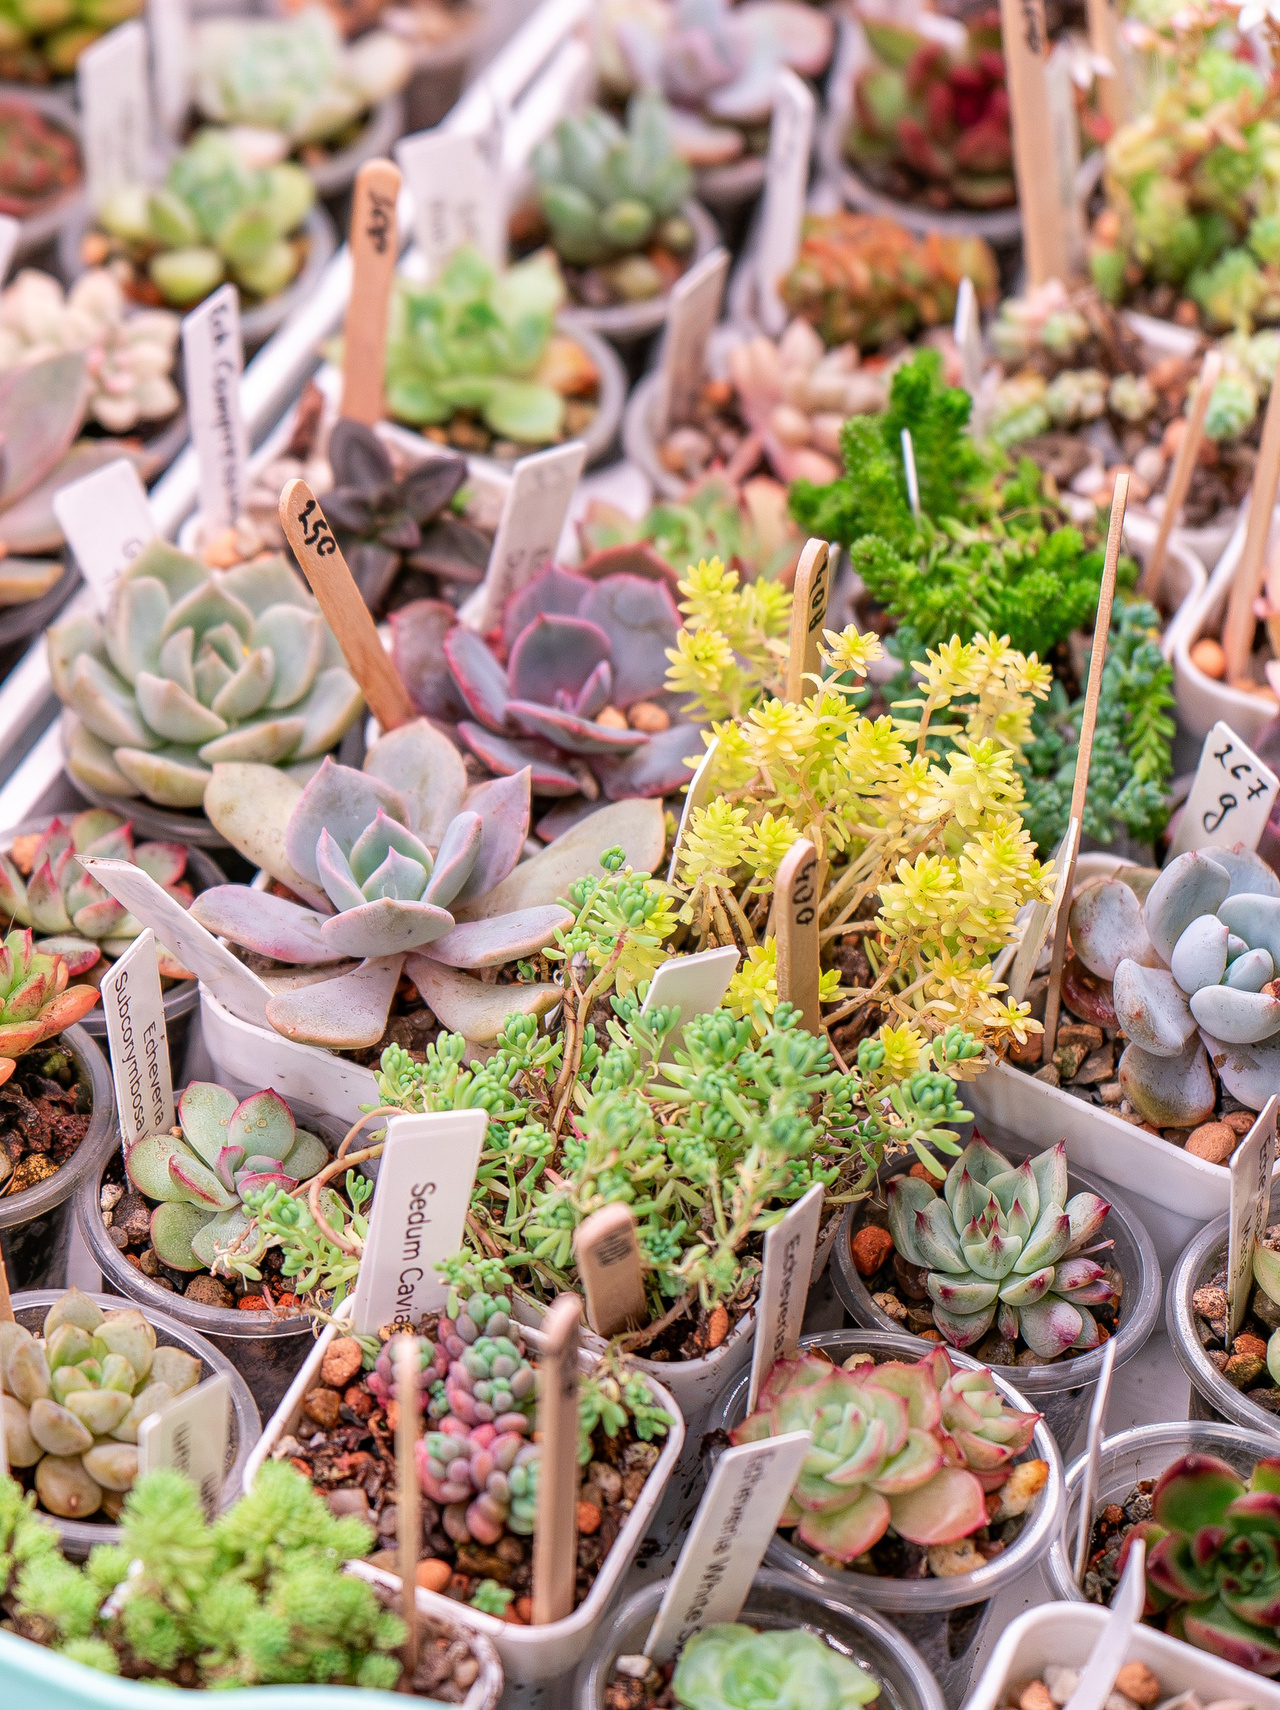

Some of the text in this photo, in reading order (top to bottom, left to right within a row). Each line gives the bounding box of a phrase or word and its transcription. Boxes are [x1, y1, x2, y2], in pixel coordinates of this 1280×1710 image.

[297, 499, 336, 556] 250
[792, 858, 819, 926] 400
[114, 971, 146, 1132] Subcorymbosa
[143, 1021, 165, 1127] Echeveria
[393, 1181, 436, 1326] Sedum Cavia
[773, 1233, 801, 1352] Echeveria
[1239, 1215, 1253, 1279] Maria
